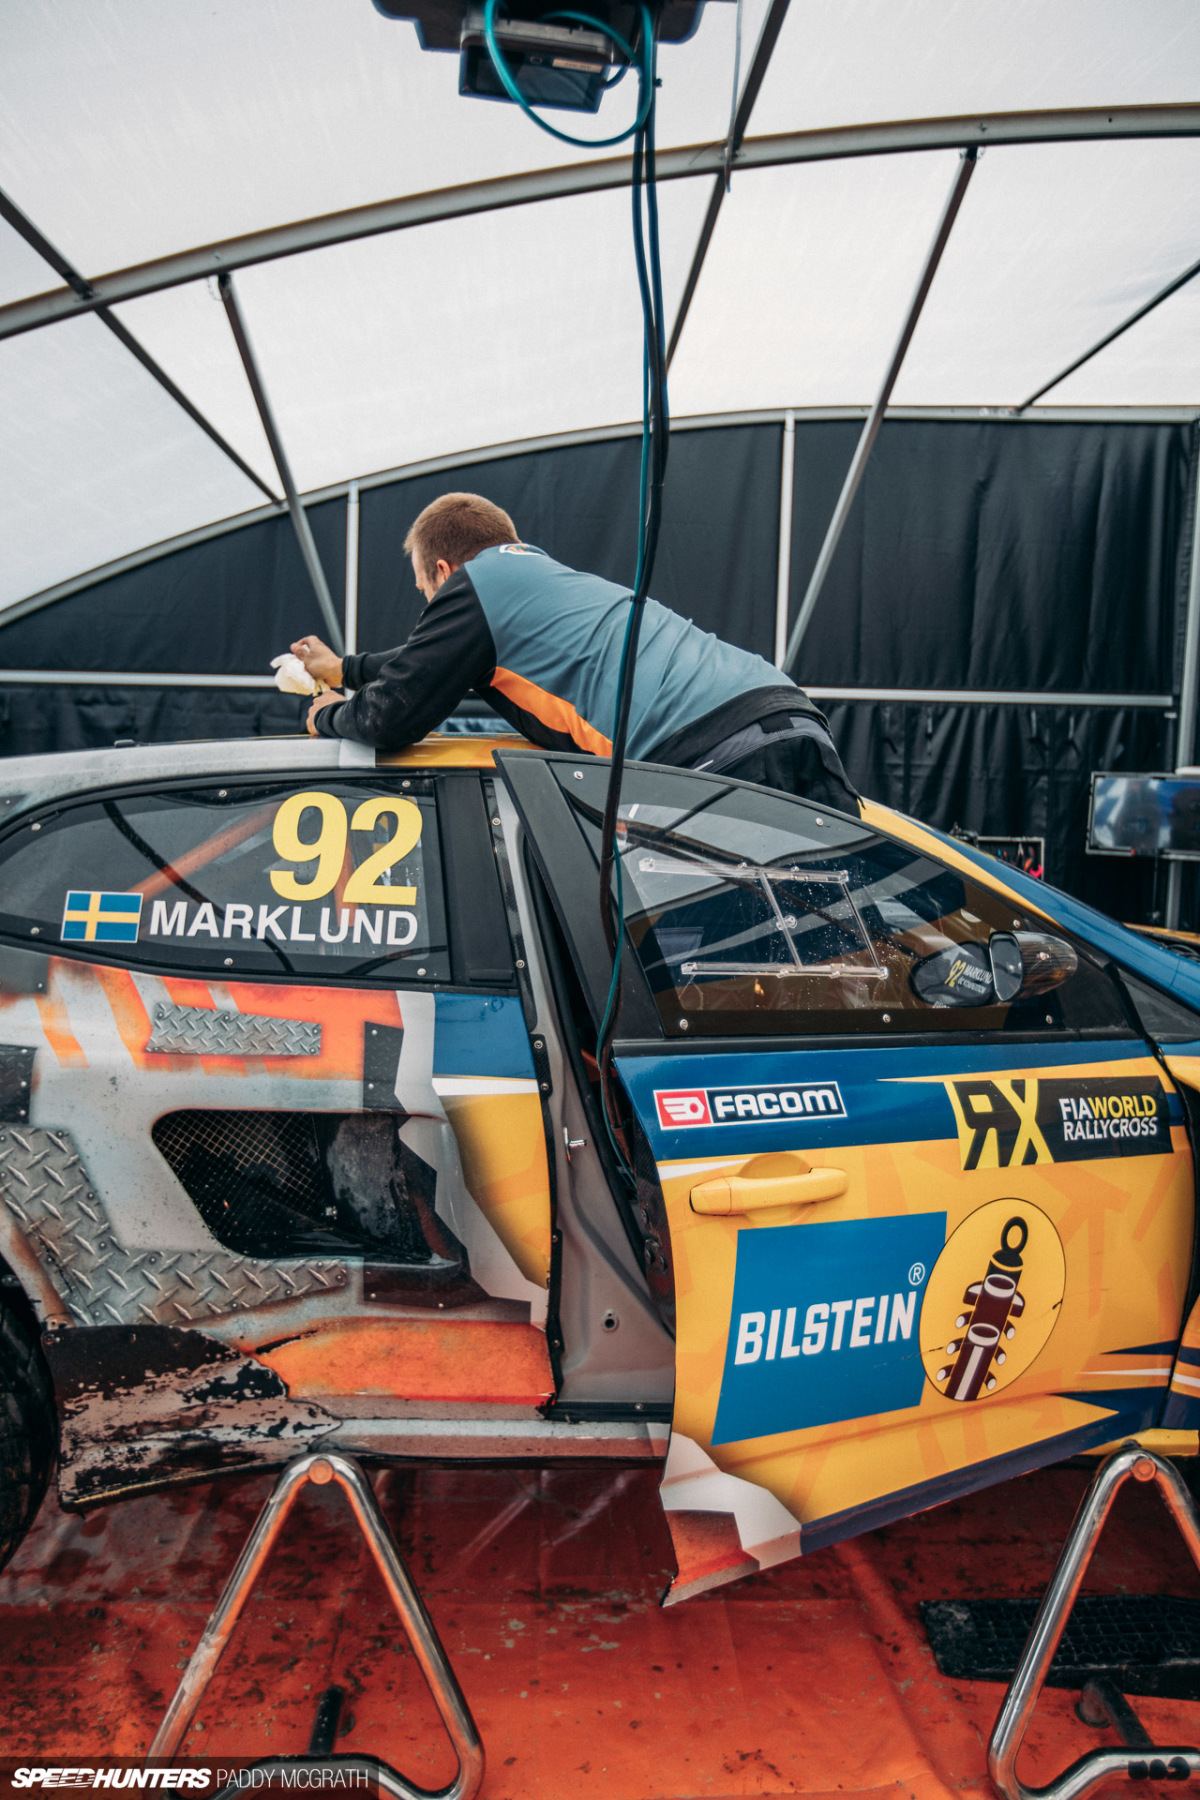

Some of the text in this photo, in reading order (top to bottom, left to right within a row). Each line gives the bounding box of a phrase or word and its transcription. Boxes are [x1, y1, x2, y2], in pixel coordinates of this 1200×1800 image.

[270, 791, 423, 906] 92
[150, 900, 418, 946] MARKLUND
[714, 1089, 838, 1118] FACOM
[1063, 1116, 1158, 1141] RALLYCROSS
[734, 1290, 917, 1365] BILSTEIN
